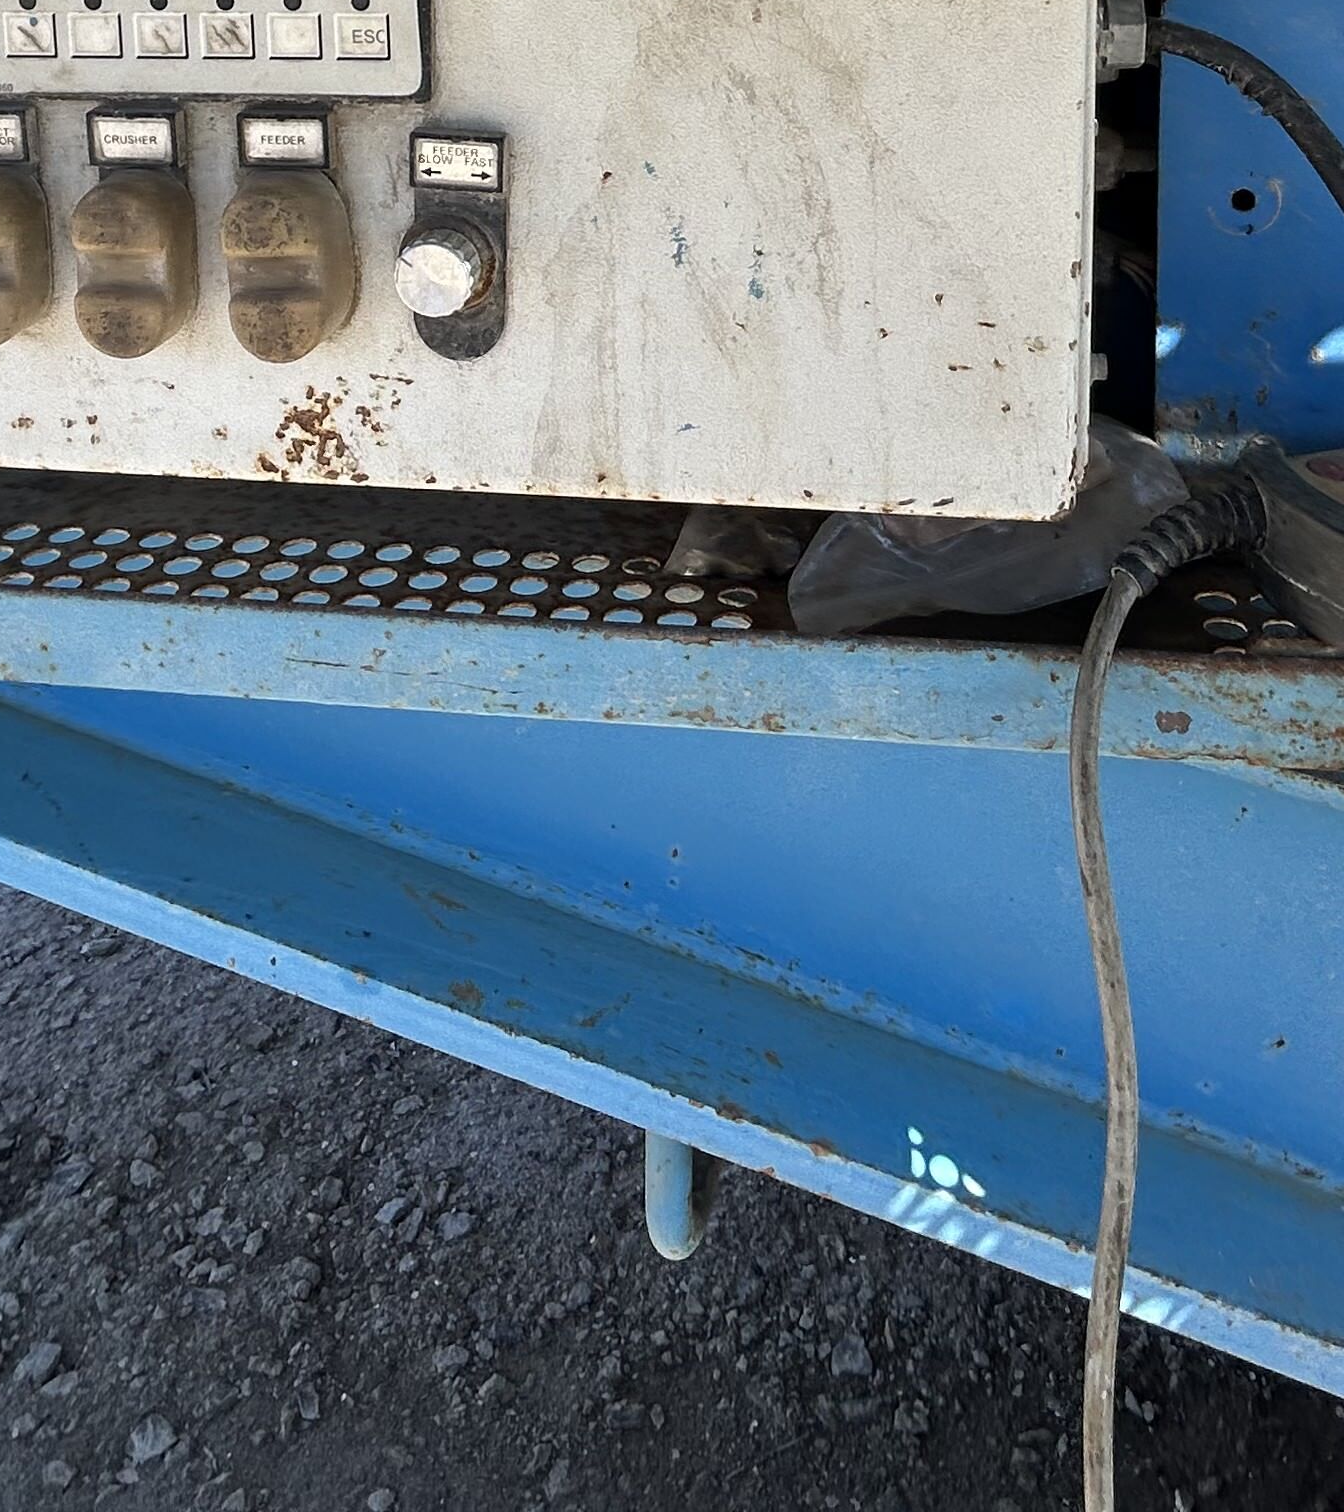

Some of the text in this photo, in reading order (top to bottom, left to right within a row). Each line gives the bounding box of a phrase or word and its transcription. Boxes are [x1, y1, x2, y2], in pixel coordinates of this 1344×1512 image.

[352, 29, 386, 44] ESC
[103, 134, 158, 145] CRUSHER
[260, 134, 306, 146] FEEDER
[432, 145, 480, 158] FEEDER
[417, 153, 494, 168] SLOW FAST
